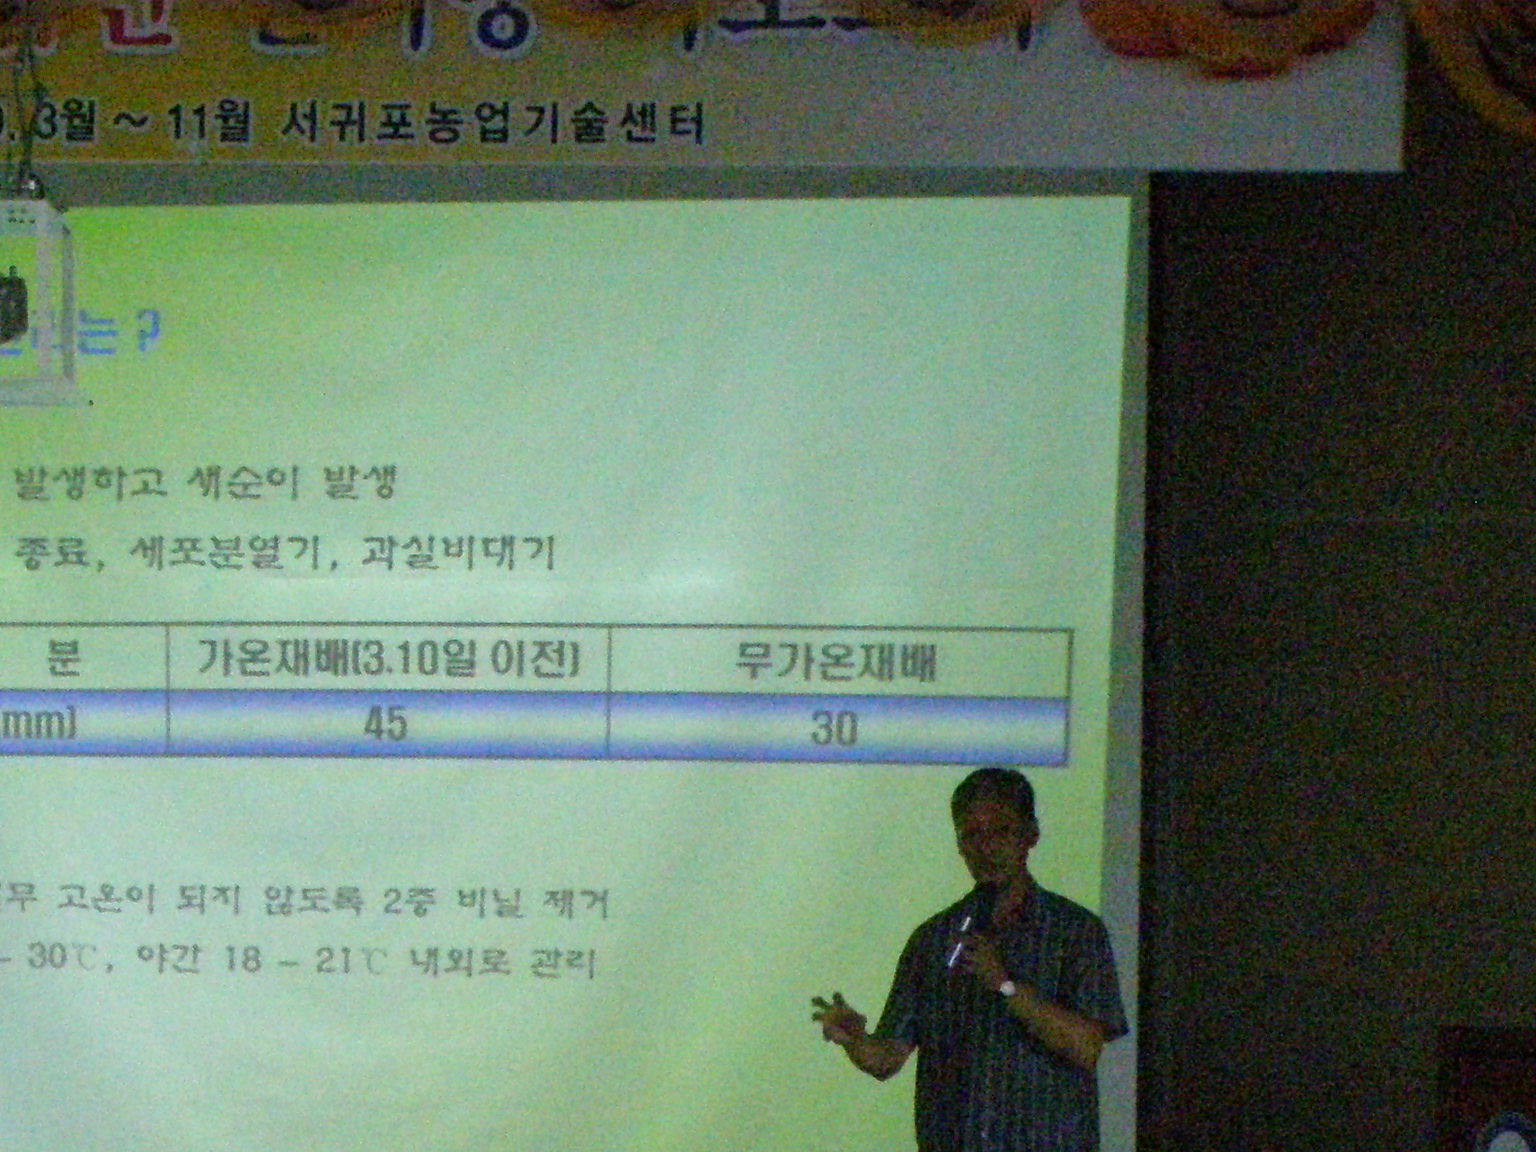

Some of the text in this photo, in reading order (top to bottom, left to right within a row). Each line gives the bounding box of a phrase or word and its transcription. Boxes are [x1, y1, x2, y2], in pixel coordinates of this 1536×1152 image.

[167, 98, 250, 143] 11월
[280, 99, 705, 145] 서귀포농업기술센터
[13, 465, 168, 501] 발생하고
[186, 463, 300, 501] 새순이
[323, 463, 398, 501] 발생
[14, 535, 106, 573] 종료,
[128, 533, 339, 573] 세포분열기,
[361, 533, 557, 572] 과실비대기
[47, 639, 81, 677] 분
[197, 637, 477, 678] 가온재배(3.10일
[489, 638, 581, 680] 이전)
[735, 640, 938, 682] 무가온재배
[364, 704, 408, 741] 45
[811, 710, 858, 748] 30
[57, 882, 155, 915] 고온이
[176, 883, 241, 916] 되지
[264, 884, 364, 917] 않도록
[383, 886, 437, 918] 2중
[457, 886, 525, 919] 비닐
[136, 942, 202, 974] 야간
[226, 944, 263, 974] 18
[409, 946, 512, 977] 내외로
[530, 947, 596, 980] 관리
